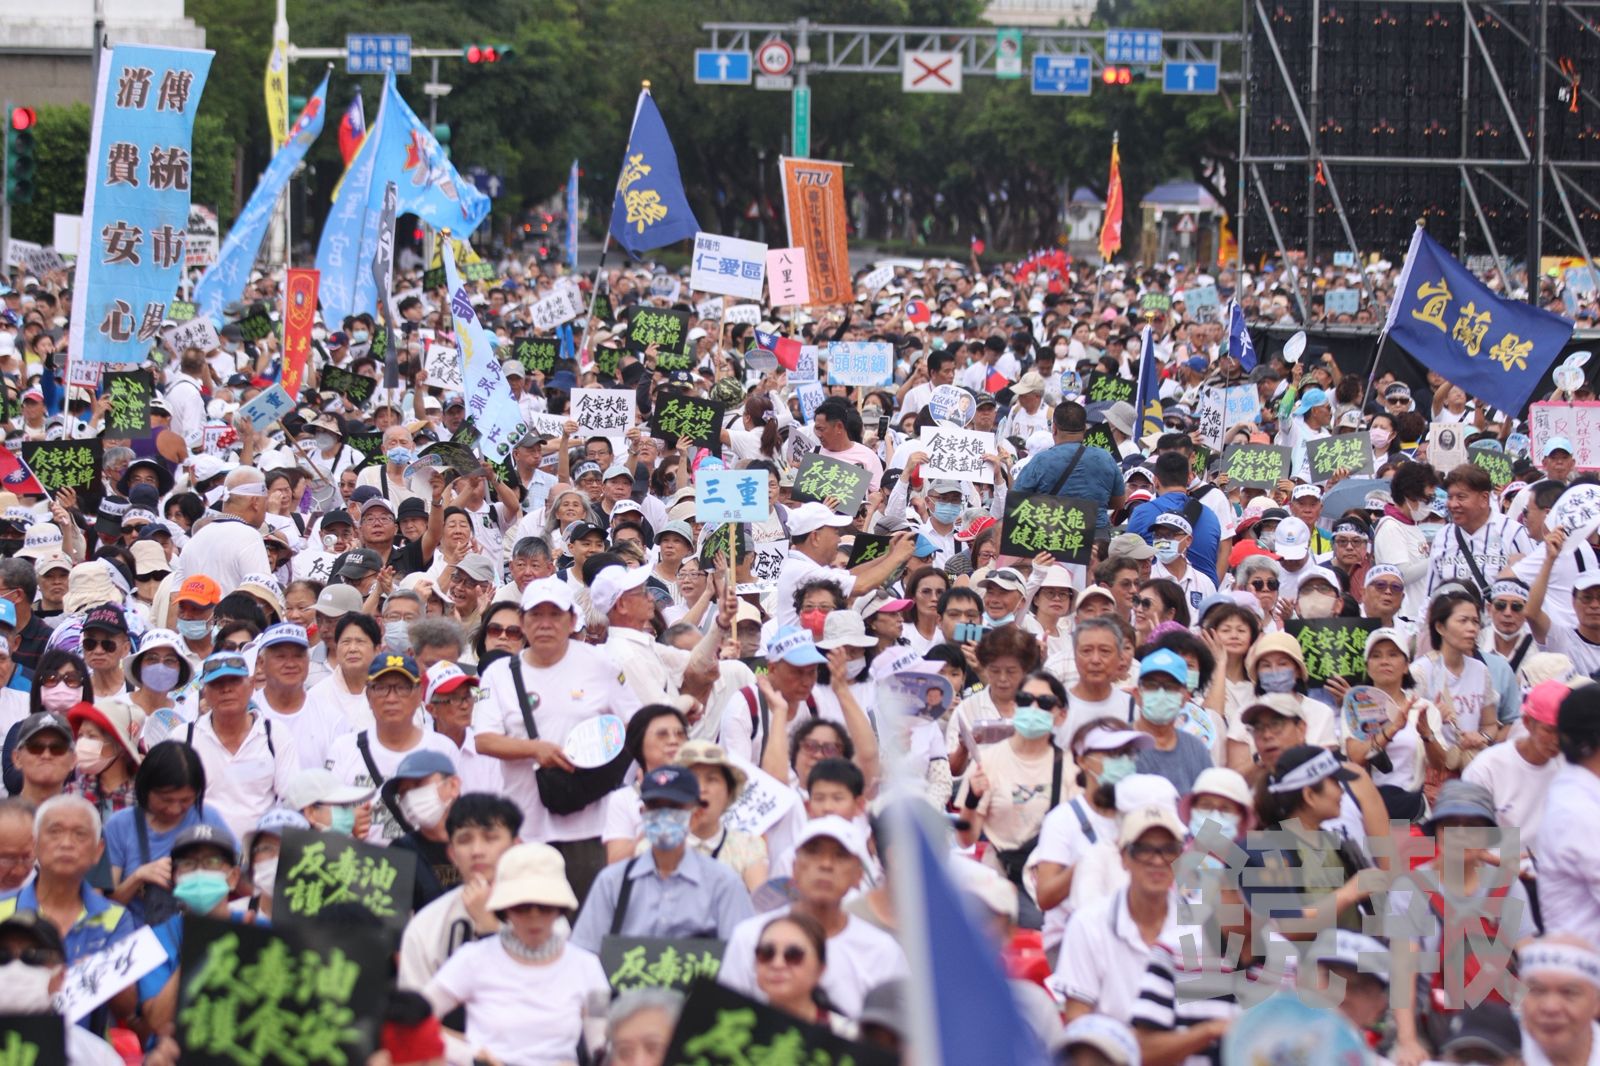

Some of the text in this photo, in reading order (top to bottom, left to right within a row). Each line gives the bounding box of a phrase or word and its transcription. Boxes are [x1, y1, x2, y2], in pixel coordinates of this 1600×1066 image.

[795, 169, 832, 186] TTU
[101, 67, 153, 343] 消費安心
[138, 70, 194, 343] 傳統市場
[696, 252, 763, 281] 仁愛區
[779, 253, 796, 299] 八里二
[1412, 277, 1534, 372] 宜蘭縣
[834, 353, 886, 373] 頭城鎮
[576, 393, 629, 413] 食安失能
[660, 399, 716, 422] 反毒油
[577, 409, 629, 432] 健康蓋牌
[927, 432, 986, 456] 食安失能
[1315, 438, 1363, 462] 反毒油
[29, 447, 95, 471] 食安失能
[928, 452, 987, 477] 健康蓋牌
[1228, 448, 1283, 468] 食安失能
[803, 459, 860, 487] 反毒油
[1227, 464, 1282, 487] 健康蓋牌
[703, 478, 758, 507] 三重
[723, 510, 742, 519] 西區
[1010, 498, 1087, 532] 食安失能
[1009, 523, 1085, 559] 健康蓋牌
[1438, 554, 1507, 567] MANCESTER
[286, 840, 398, 891] 反毒油
[187, 931, 361, 1000] 反毒油
